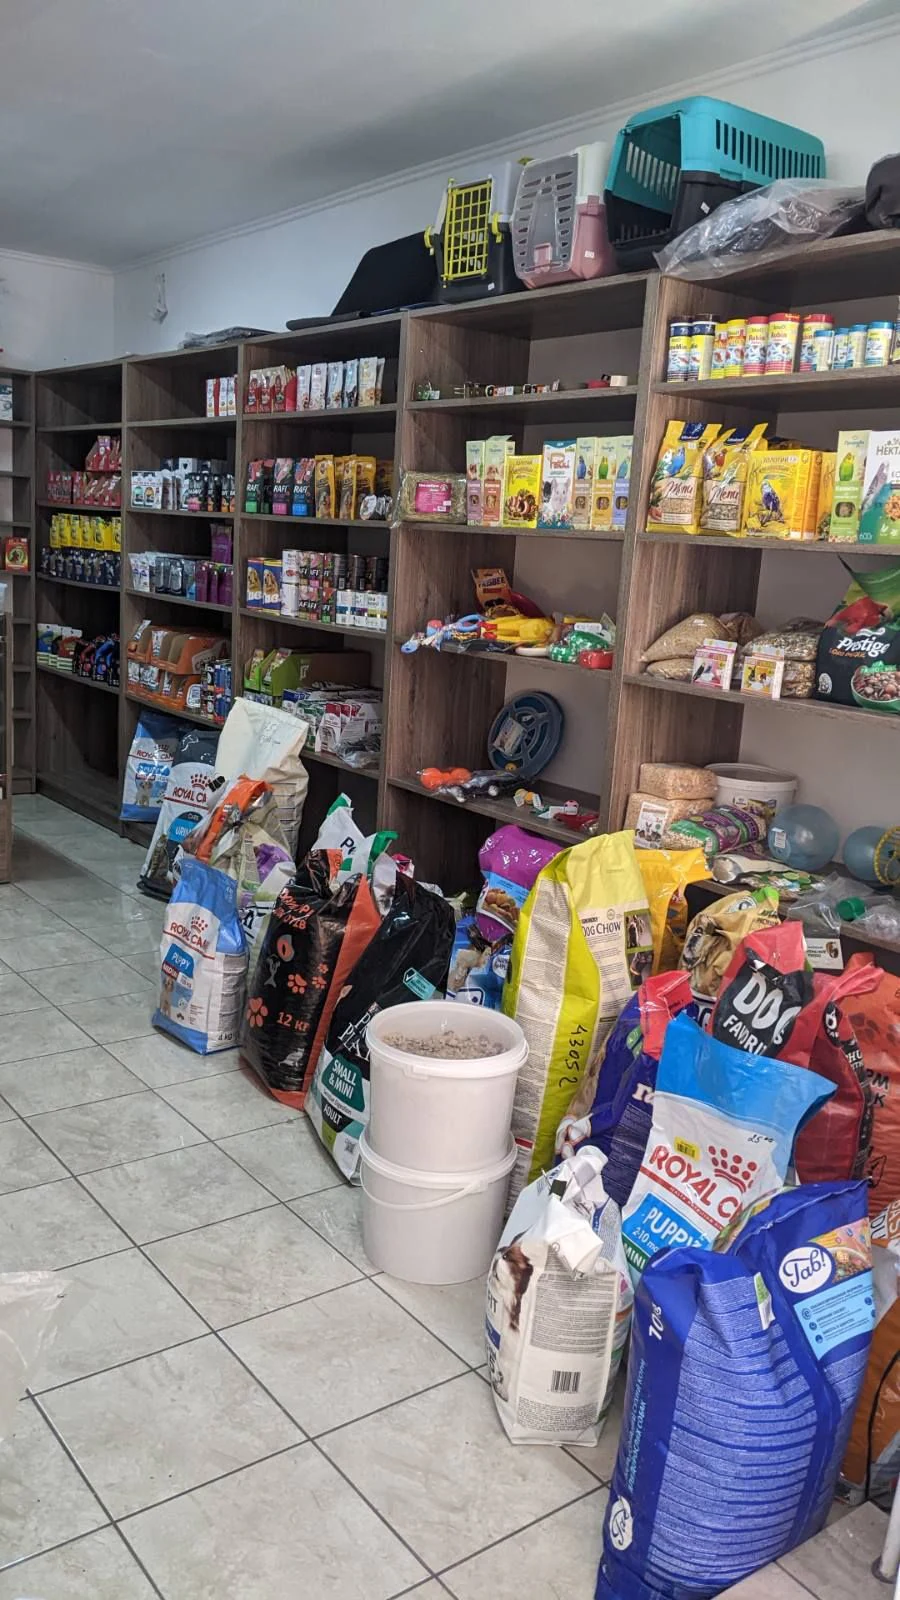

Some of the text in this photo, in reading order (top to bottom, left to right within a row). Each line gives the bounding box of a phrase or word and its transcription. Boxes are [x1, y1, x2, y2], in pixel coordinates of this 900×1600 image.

[273, 484, 288, 493] RAFI
[709, 485, 739, 503] Menu
[837, 636, 890, 658] Prestige
[172, 786, 194, 802] ROYAL
[169, 922, 192, 942] ROYAL
[596, 920, 622, 935] CHOW
[171, 951, 191, 971] PUPPY
[275, 1011, 293, 1027] 12
[331, 1059, 358, 1087] SMALL
[322, 1103, 343, 1126] ADULT
[648, 1144, 718, 1208] ROYAL
[623, 1242, 647, 1271] MINI
[782, 1248, 827, 1288] Tab!
